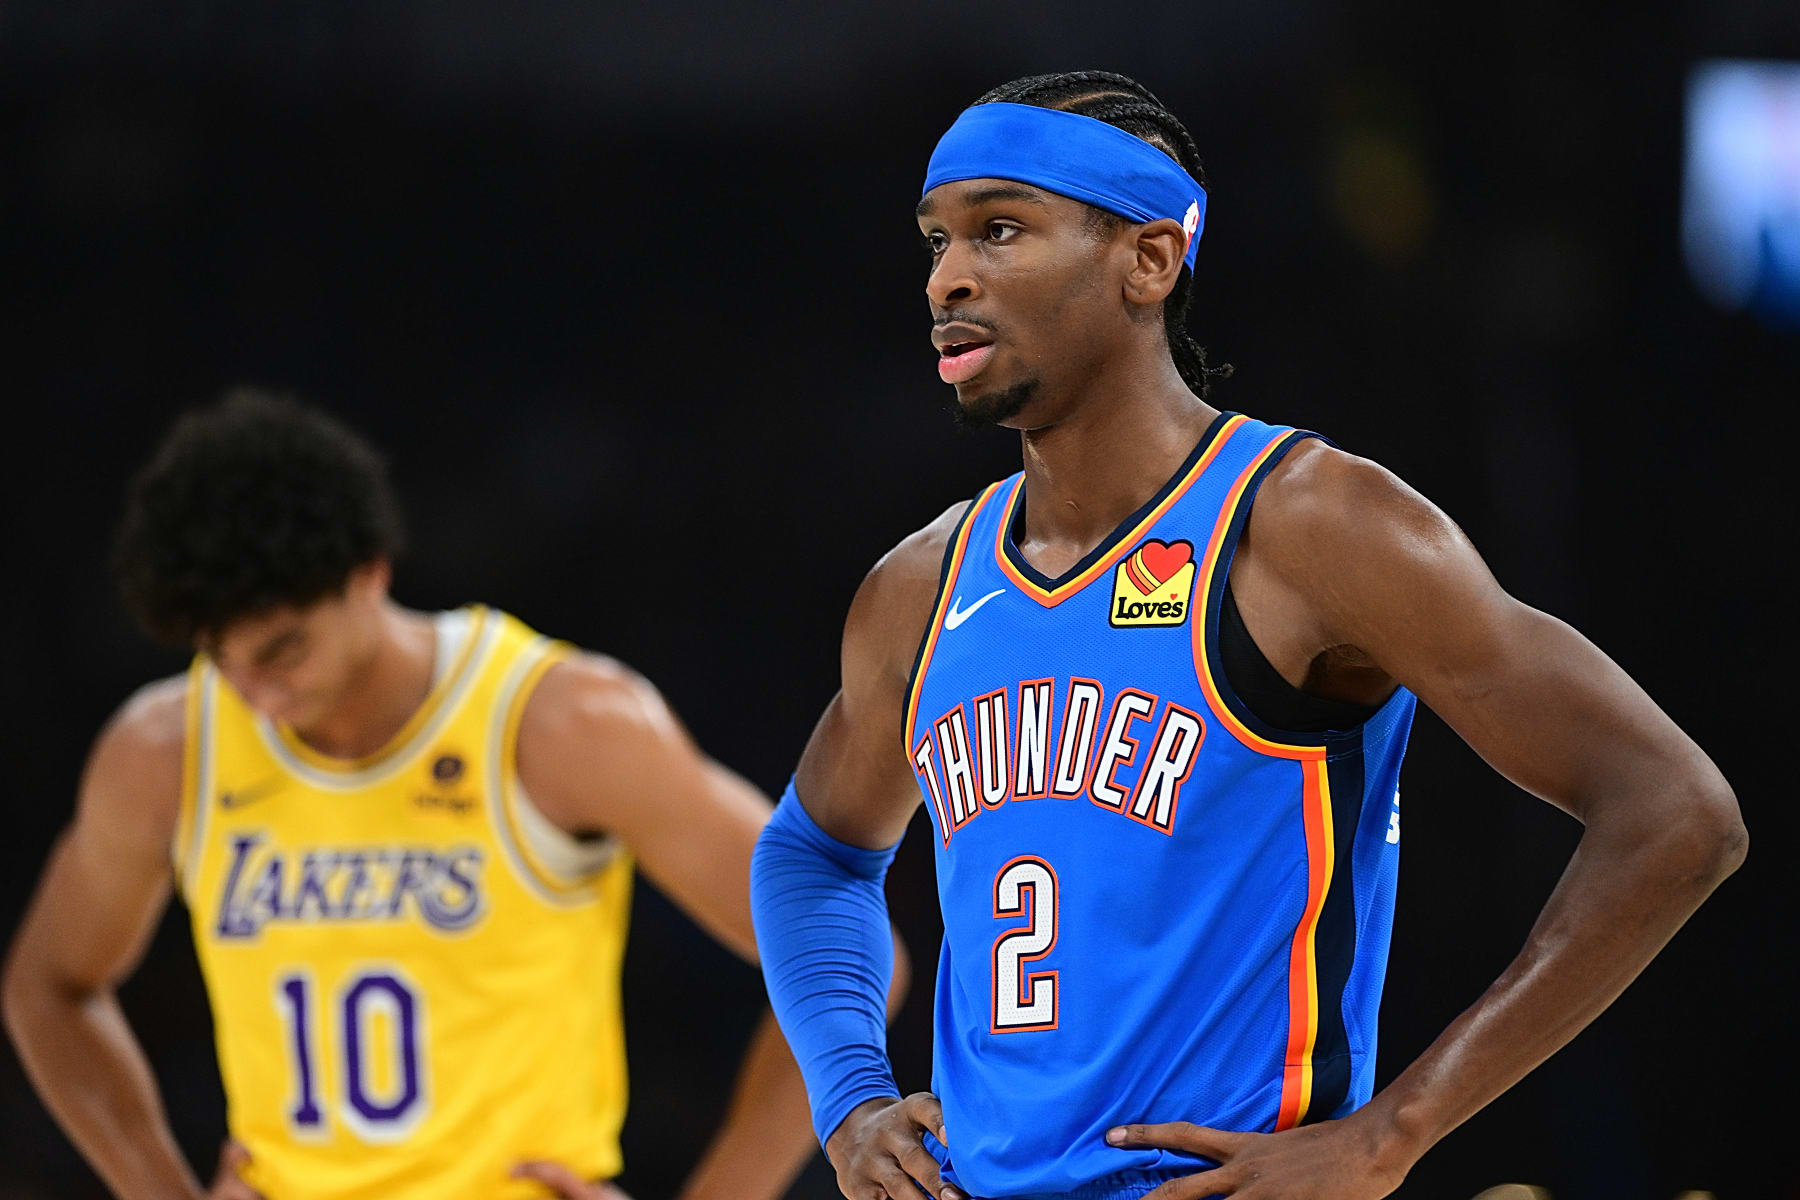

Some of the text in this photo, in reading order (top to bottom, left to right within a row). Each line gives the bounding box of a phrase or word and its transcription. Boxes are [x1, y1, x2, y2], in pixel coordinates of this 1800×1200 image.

[911, 676, 1206, 850] THUNDER
[216, 834, 482, 935] LAKERS
[990, 855, 1059, 1034] 2
[276, 968, 424, 1132] 10
